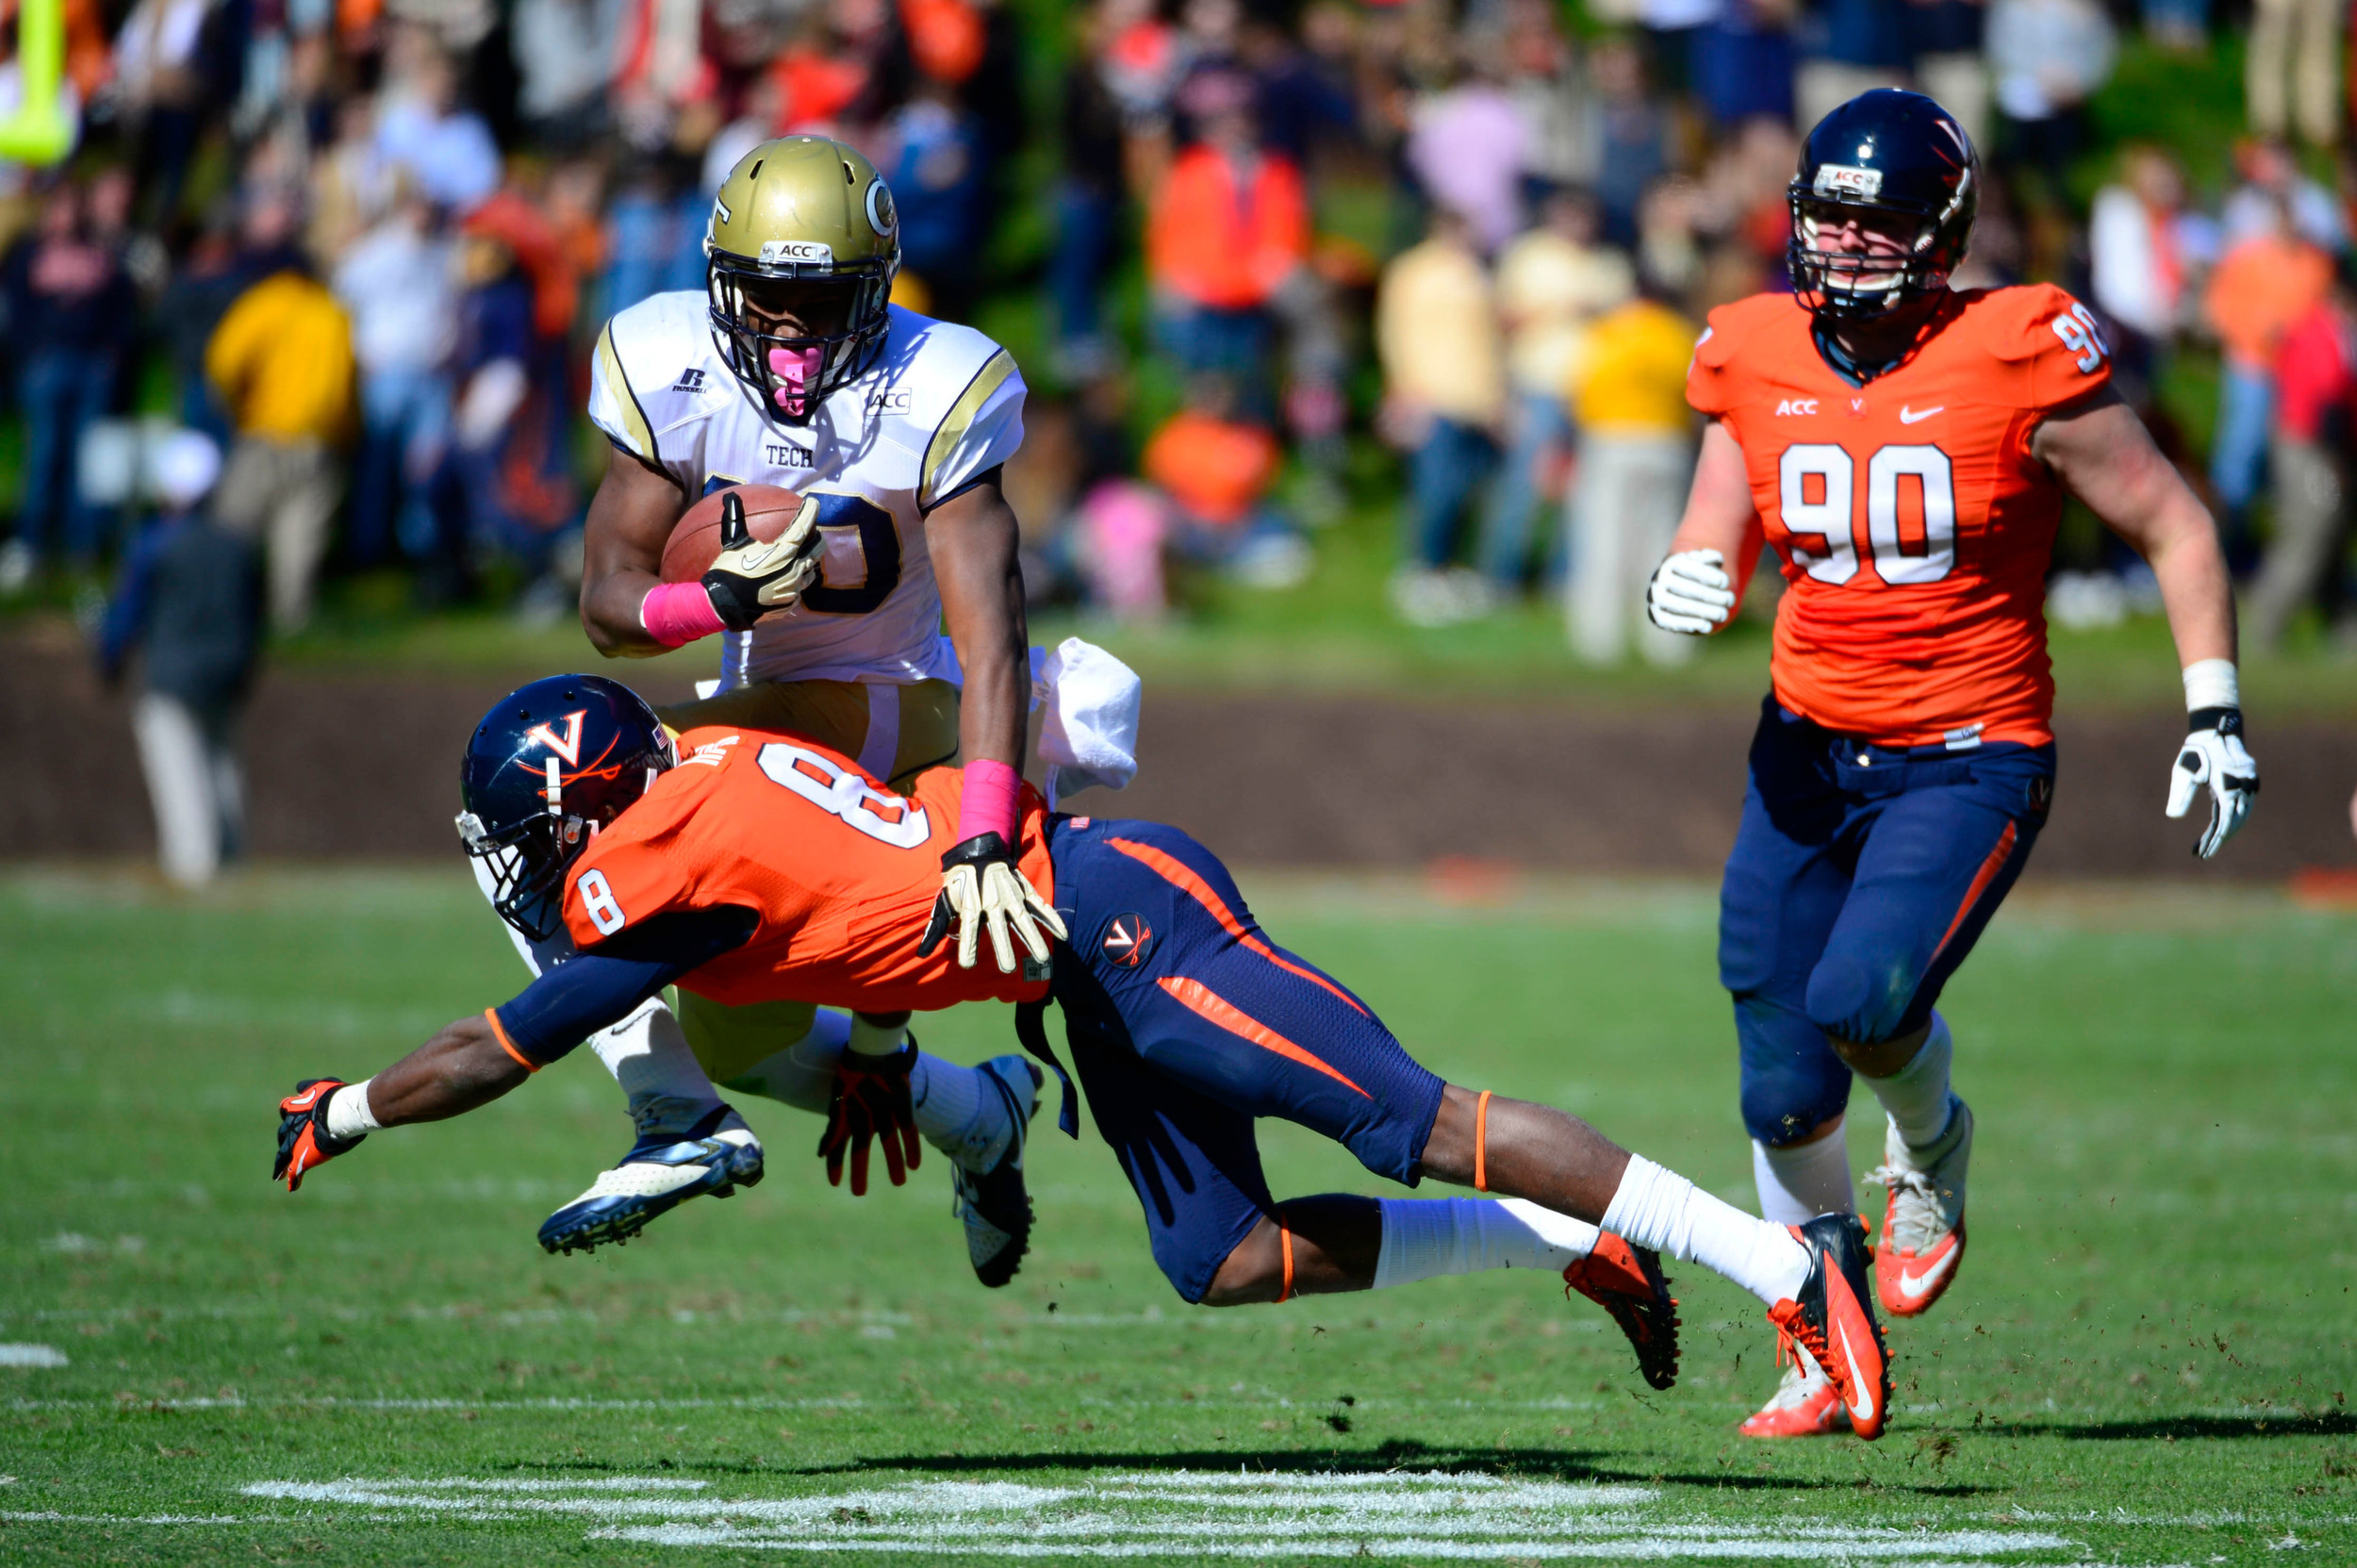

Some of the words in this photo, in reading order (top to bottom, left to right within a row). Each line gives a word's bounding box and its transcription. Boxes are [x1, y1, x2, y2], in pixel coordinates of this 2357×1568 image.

[1833, 171, 1863, 185] ACC
[780, 244, 814, 257] ACC
[671, 385, 707, 394] RUSSELL
[870, 393, 910, 409] ACC
[1775, 400, 1819, 416] ACC
[766, 444, 814, 469] TECH
[1778, 443, 1958, 586] 90
[527, 709, 588, 768] V
[755, 742, 931, 850] 8
[577, 867, 627, 937] 8
